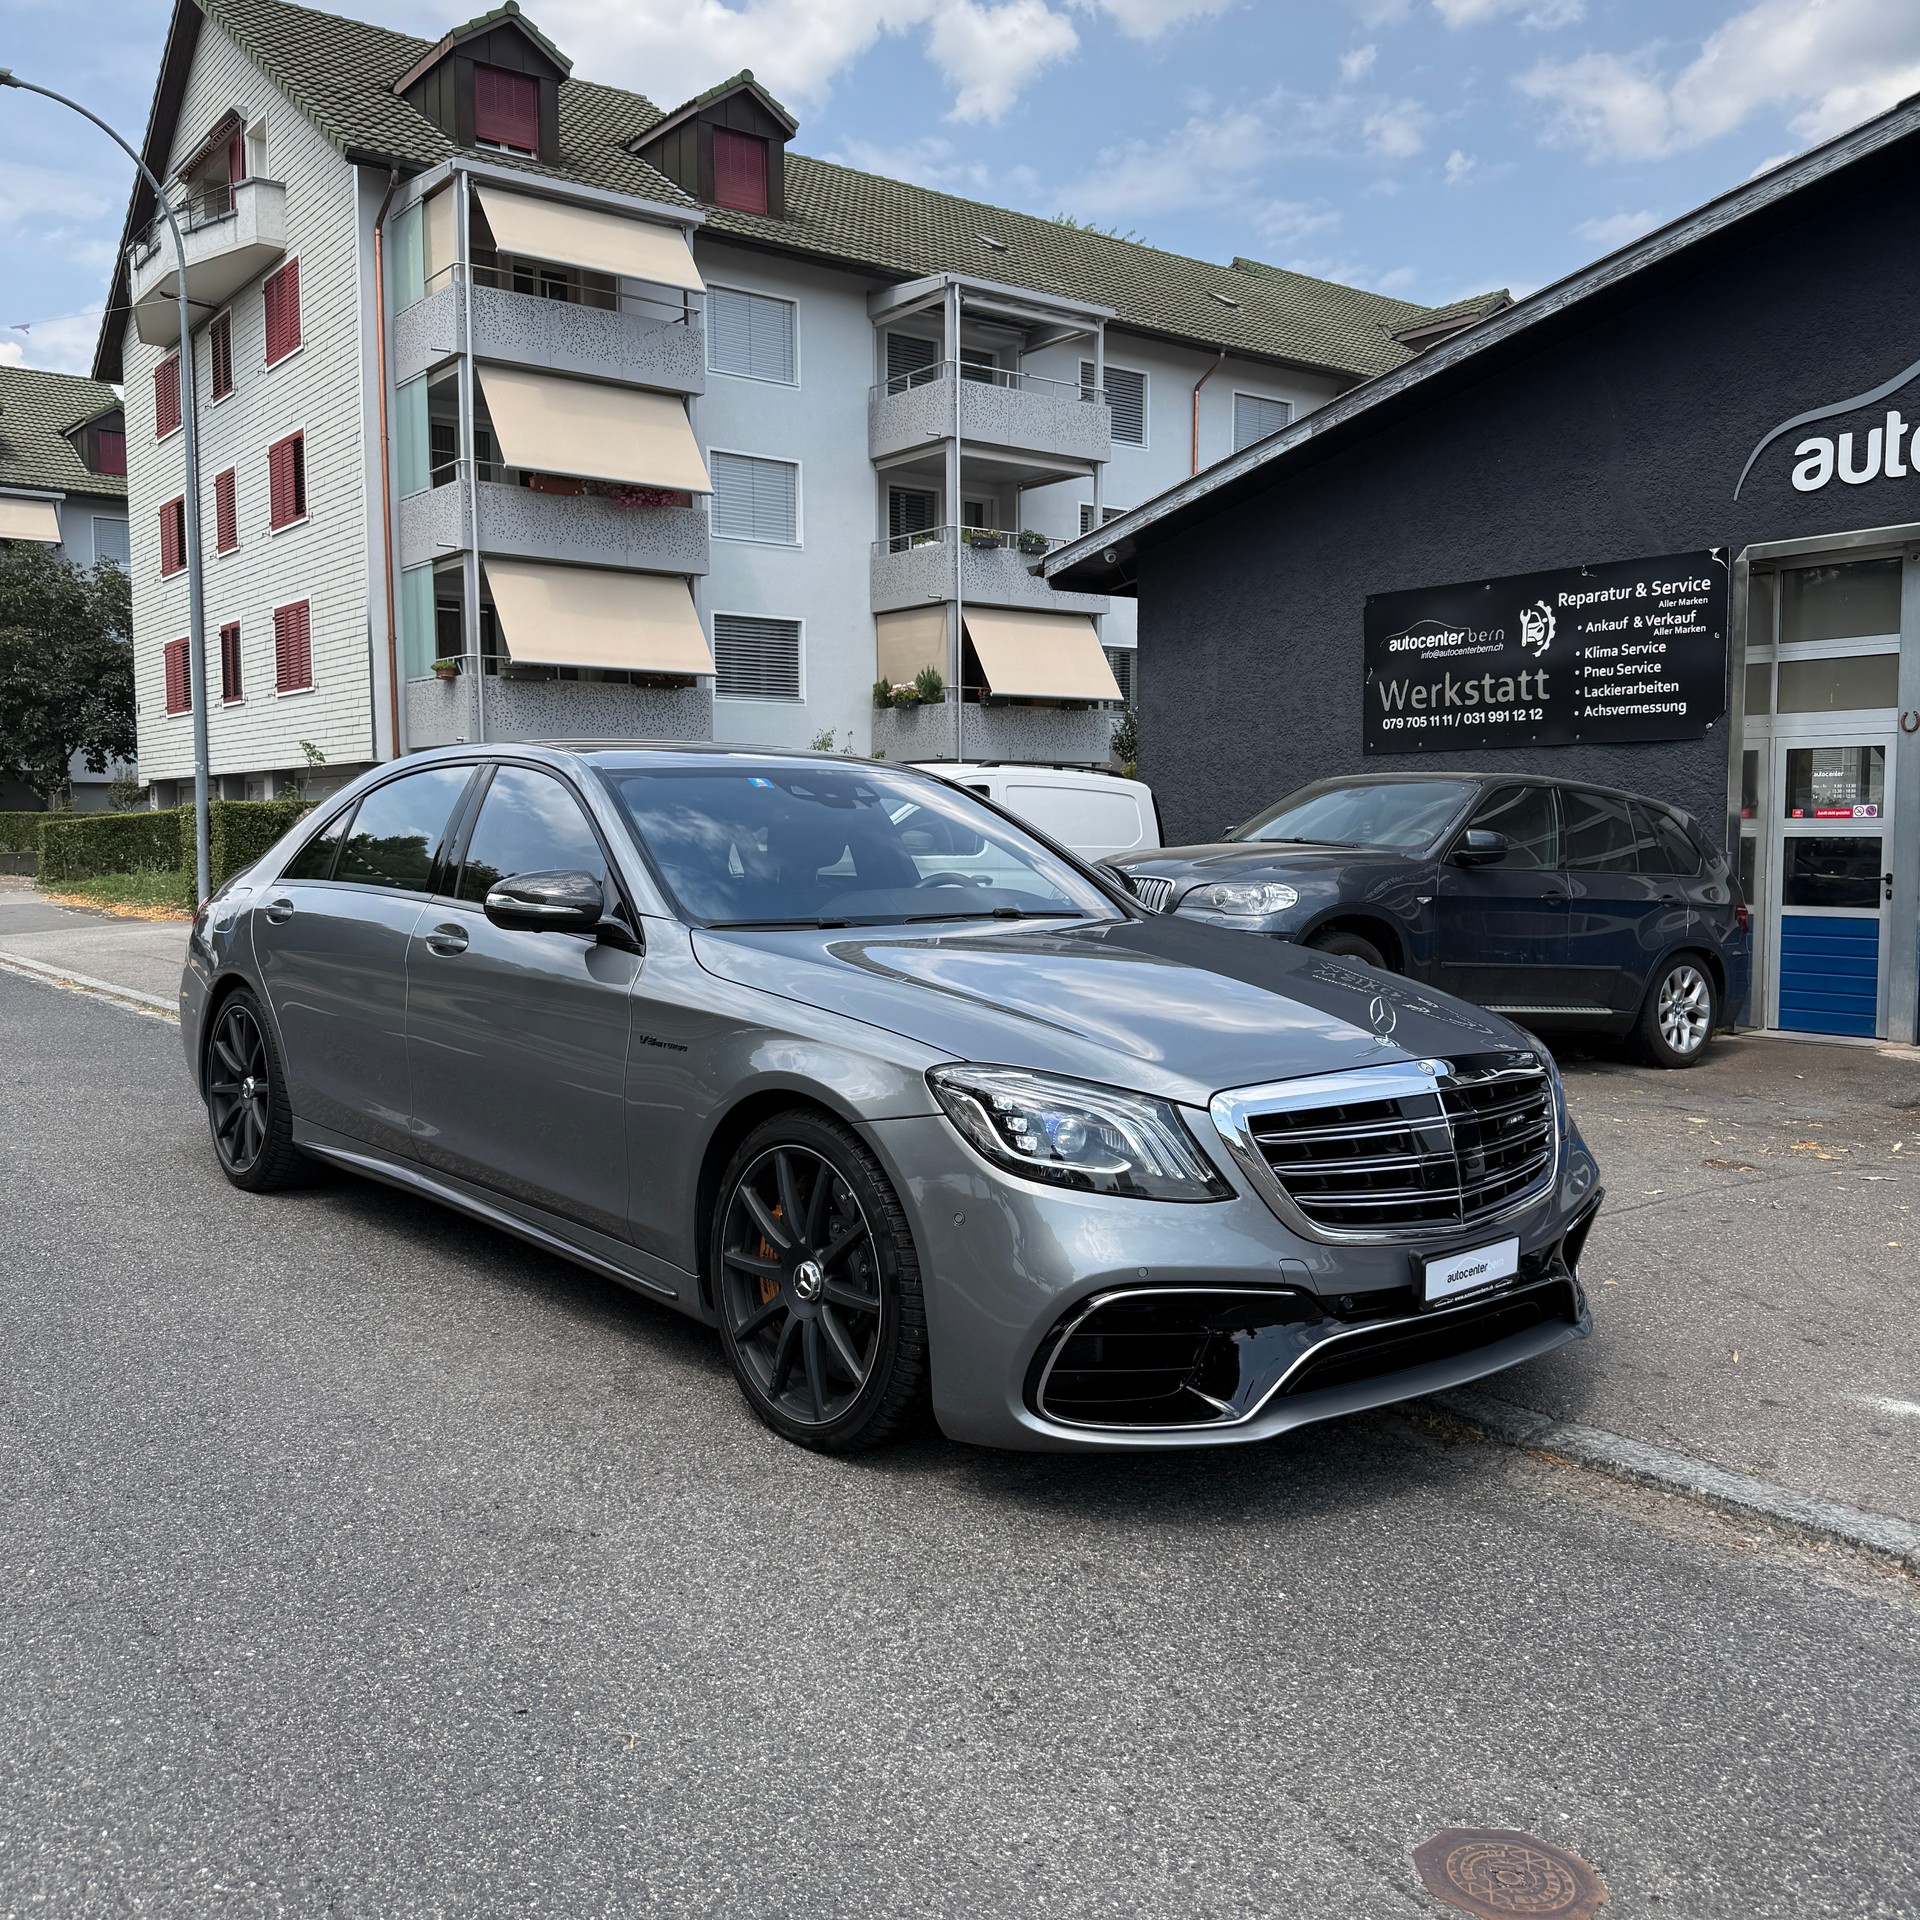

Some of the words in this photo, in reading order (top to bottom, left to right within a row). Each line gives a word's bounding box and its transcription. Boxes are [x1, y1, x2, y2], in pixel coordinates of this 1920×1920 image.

[1791, 410, 1920, 492] aut
[1558, 587, 1632, 609] Reparatur
[1635, 583, 1648, 598] &
[1651, 576, 1711, 596] Service
[1658, 599, 1677, 608] Aller
[1678, 597, 1708, 606] Marken
[1585, 616, 1629, 633] Ankauf
[1633, 616, 1643, 627] &
[1645, 610, 1697, 627] Verkauf
[1653, 627, 1672, 636] Aller
[1674, 625, 1706, 634] Marken
[1389, 631, 1465, 652] autocenter
[1468, 628, 1505, 642] bern
[1420, 643, 1504, 660] info@autocenterbern.ch
[1584, 645, 1618, 659] Klima
[1621, 641, 1667, 656] Service
[1584, 666, 1614, 678] Pneu
[1616, 661, 1662, 675] Service
[1379, 668, 1550, 712] Werkstatt
[1584, 680, 1679, 698] Lackierarbeiten
[1382, 718, 1404, 730] 079
[1406, 716, 1428, 728] 705
[1429, 715, 1440, 727] 11
[1442, 714, 1453, 726] 11
[1455, 713, 1461, 727] /
[1463, 712, 1486, 725] 031
[1488, 710, 1510, 723] 991
[1512, 709, 1526, 721] 12
[1528, 708, 1543, 720] 12
[1584, 702, 1687, 718] Achsvermessung
[1447, 1263, 1488, 1283] autocenter
